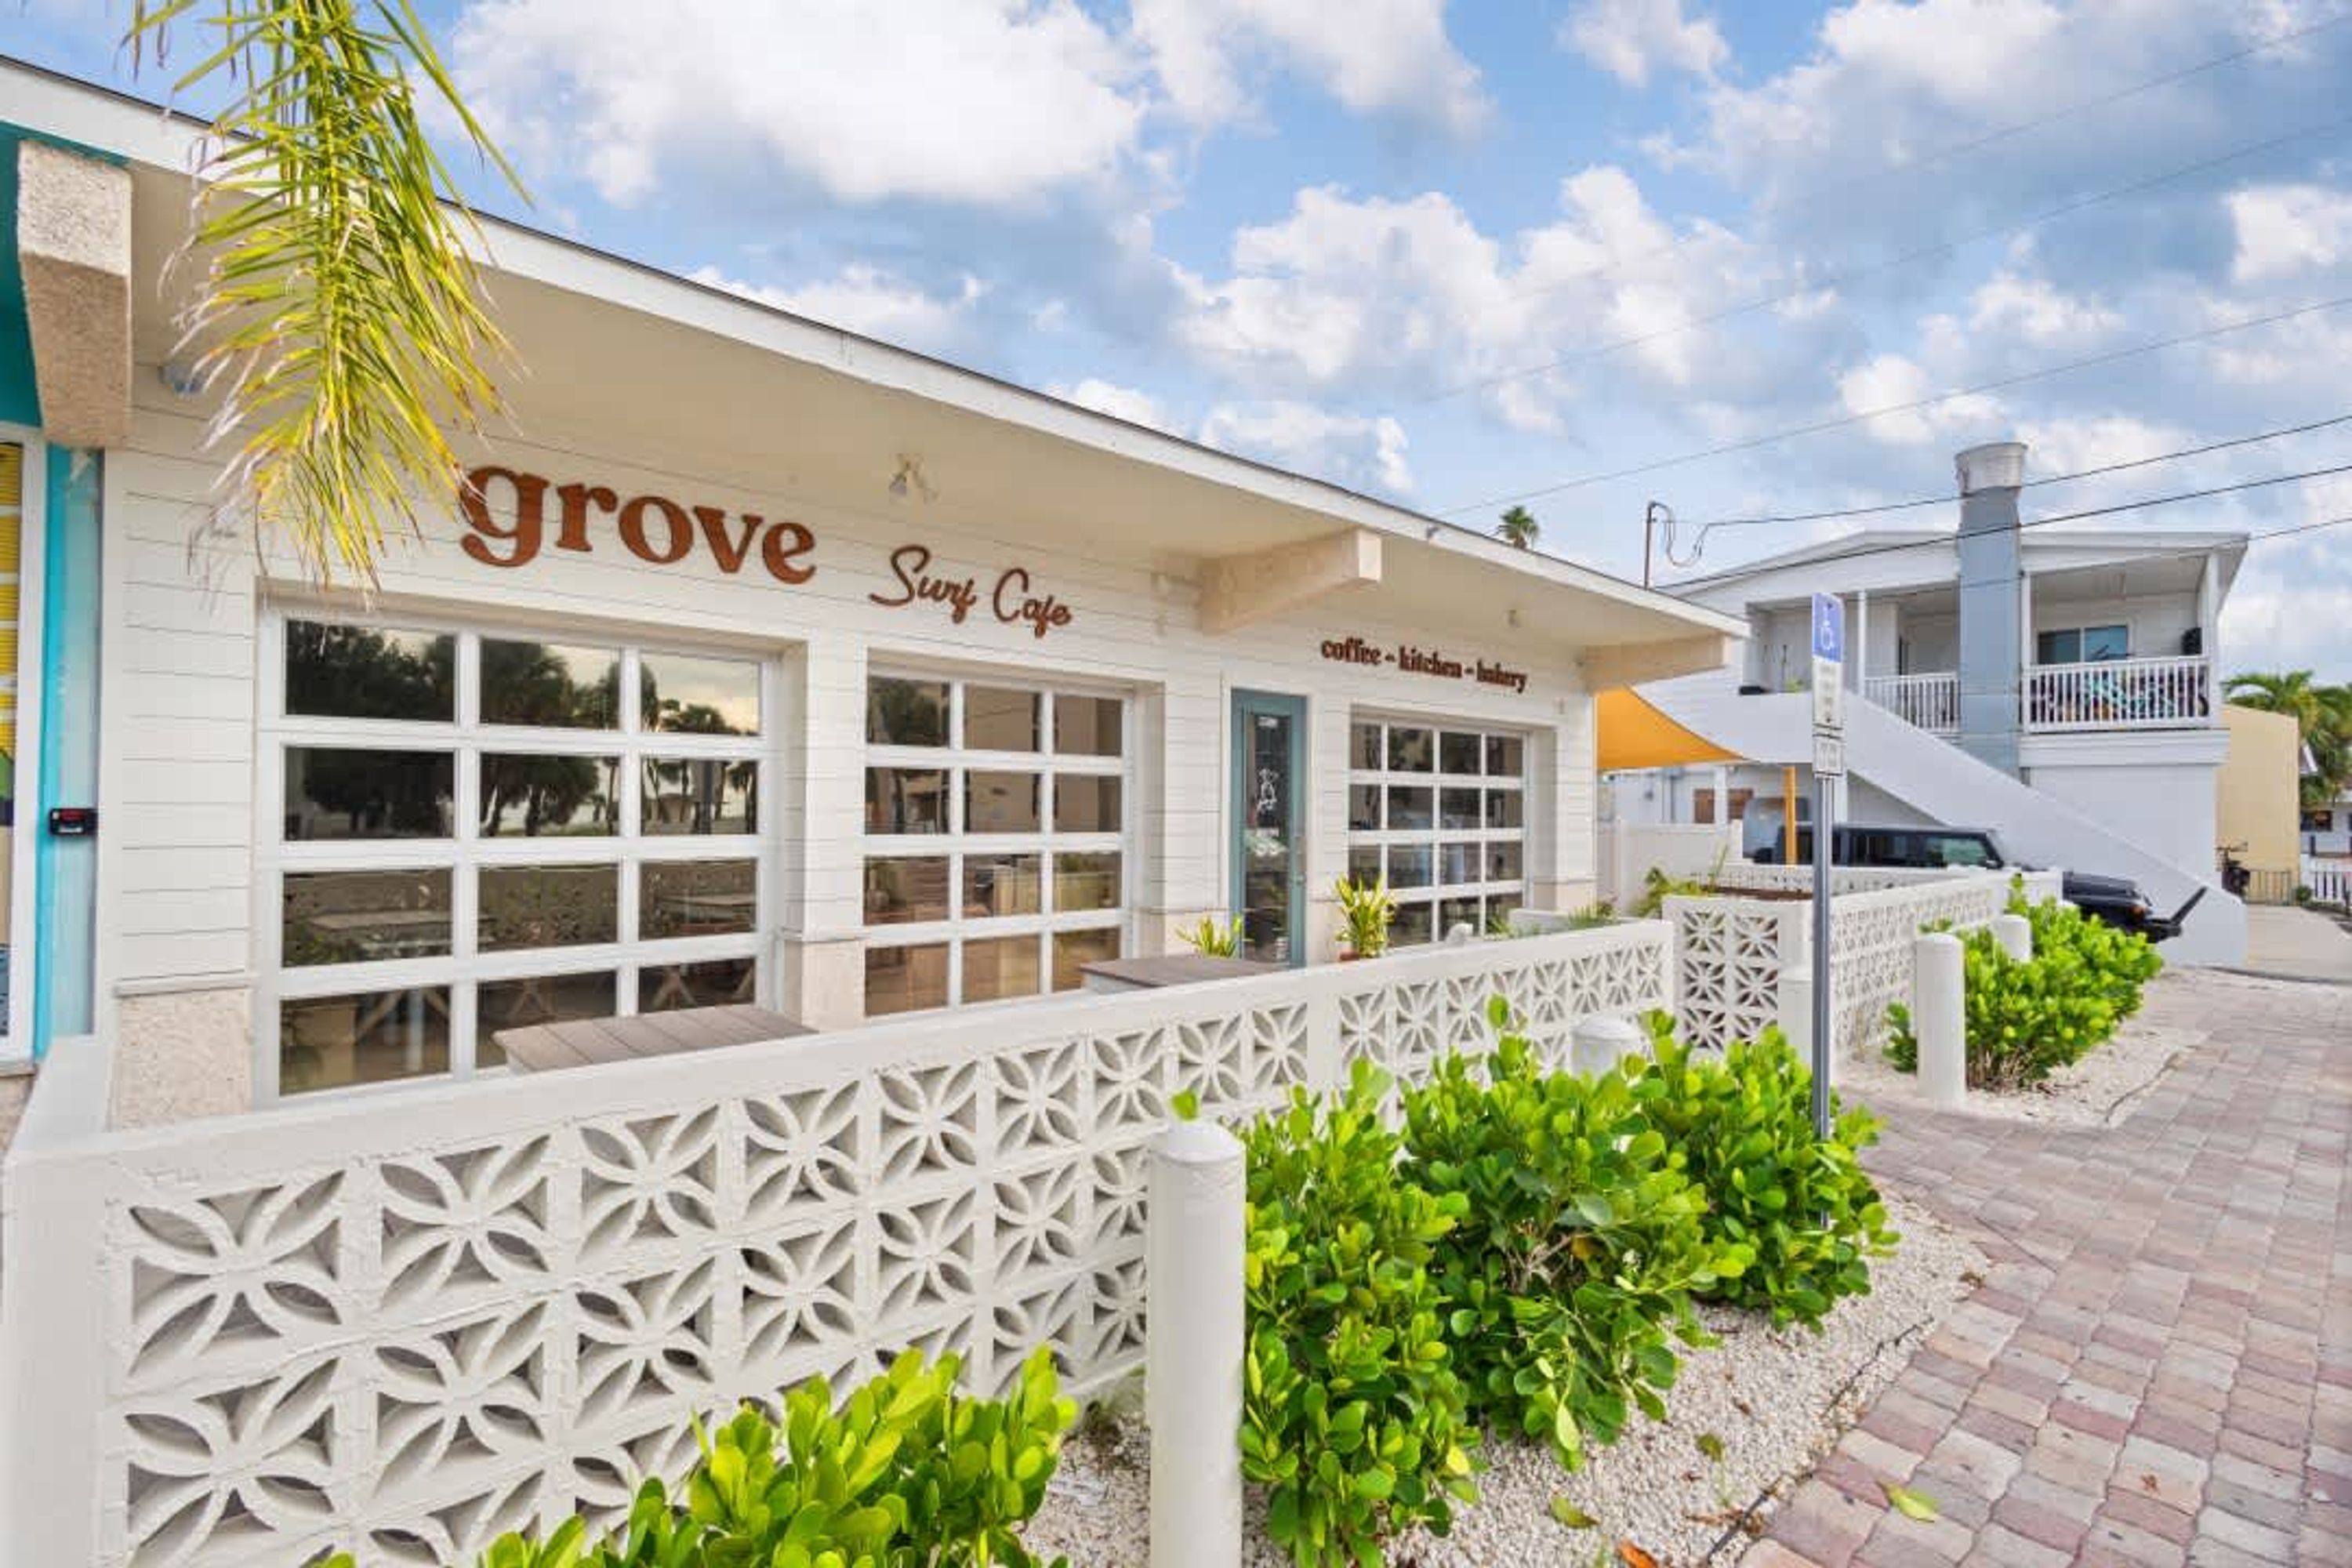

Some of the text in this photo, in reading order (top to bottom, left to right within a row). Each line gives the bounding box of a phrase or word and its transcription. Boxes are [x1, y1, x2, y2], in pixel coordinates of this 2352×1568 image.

[459, 466, 817, 585] grove
[868, 544, 1073, 639] Surf Cafe
[1321, 636, 1382, 666] coffee
[1399, 645, 1462, 678] kitchen
[1476, 657, 1527, 694] bakery
